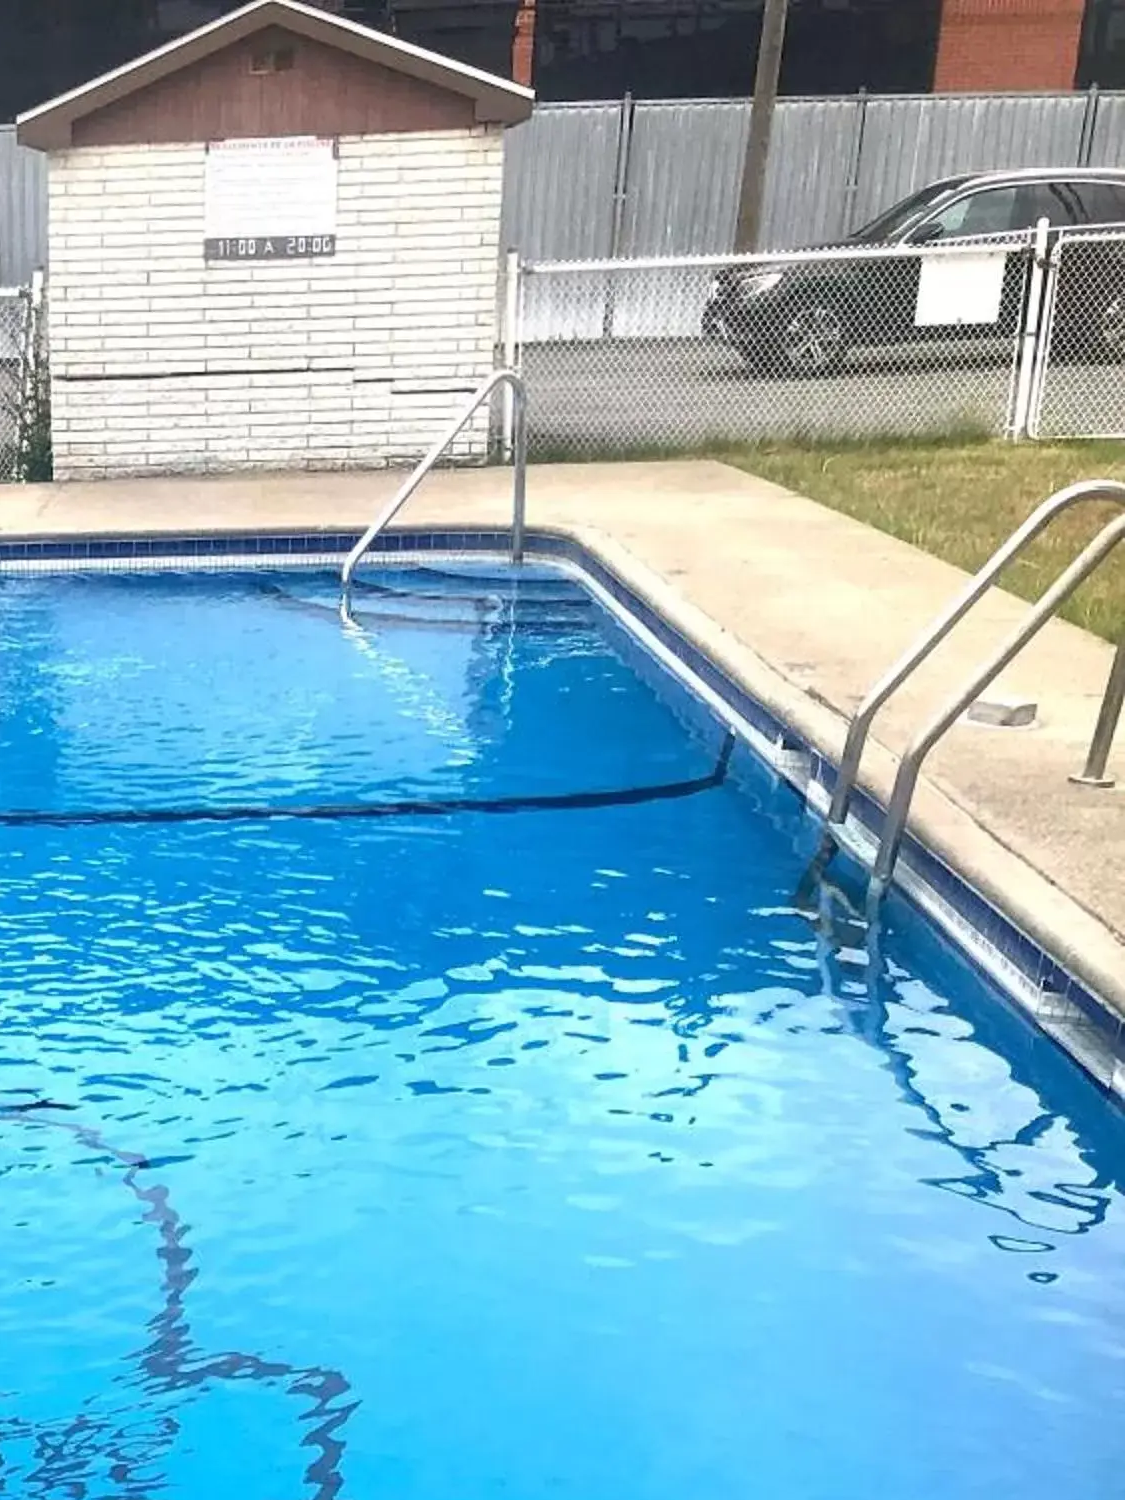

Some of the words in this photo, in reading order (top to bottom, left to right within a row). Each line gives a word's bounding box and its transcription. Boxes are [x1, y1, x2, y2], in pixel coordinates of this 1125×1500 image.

[218, 239, 256, 256] 11:00
[263, 240, 274, 255] A
[286, 237, 332, 255] 20:00
